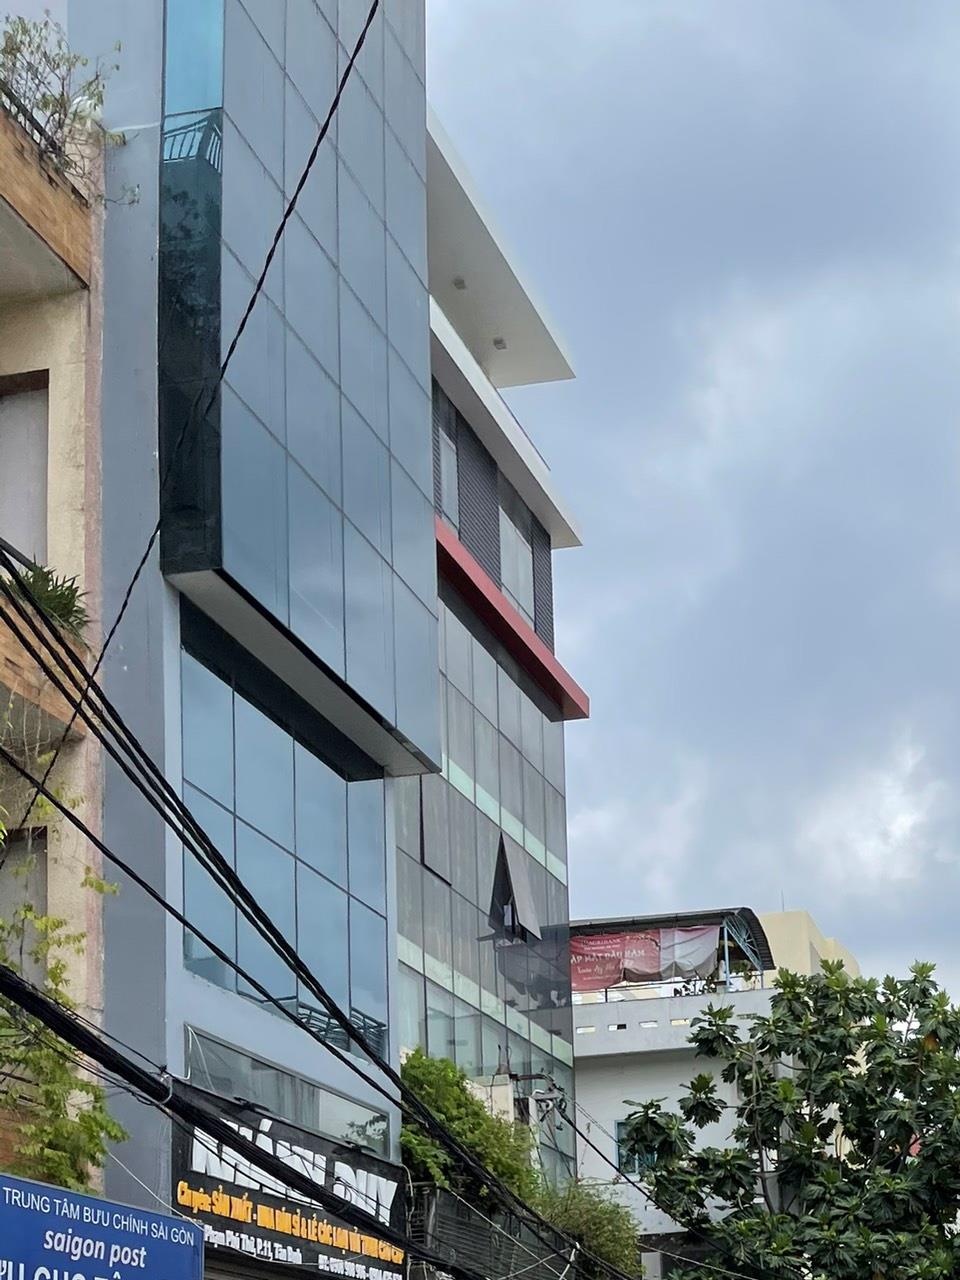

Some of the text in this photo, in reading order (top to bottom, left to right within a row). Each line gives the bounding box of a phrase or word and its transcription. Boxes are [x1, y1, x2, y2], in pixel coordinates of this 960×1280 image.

[3, 1187, 194, 1247] TRUNG TÂM BƯU CHÍNH SÀI GÒN
[44, 1228, 147, 1268] saigon post
